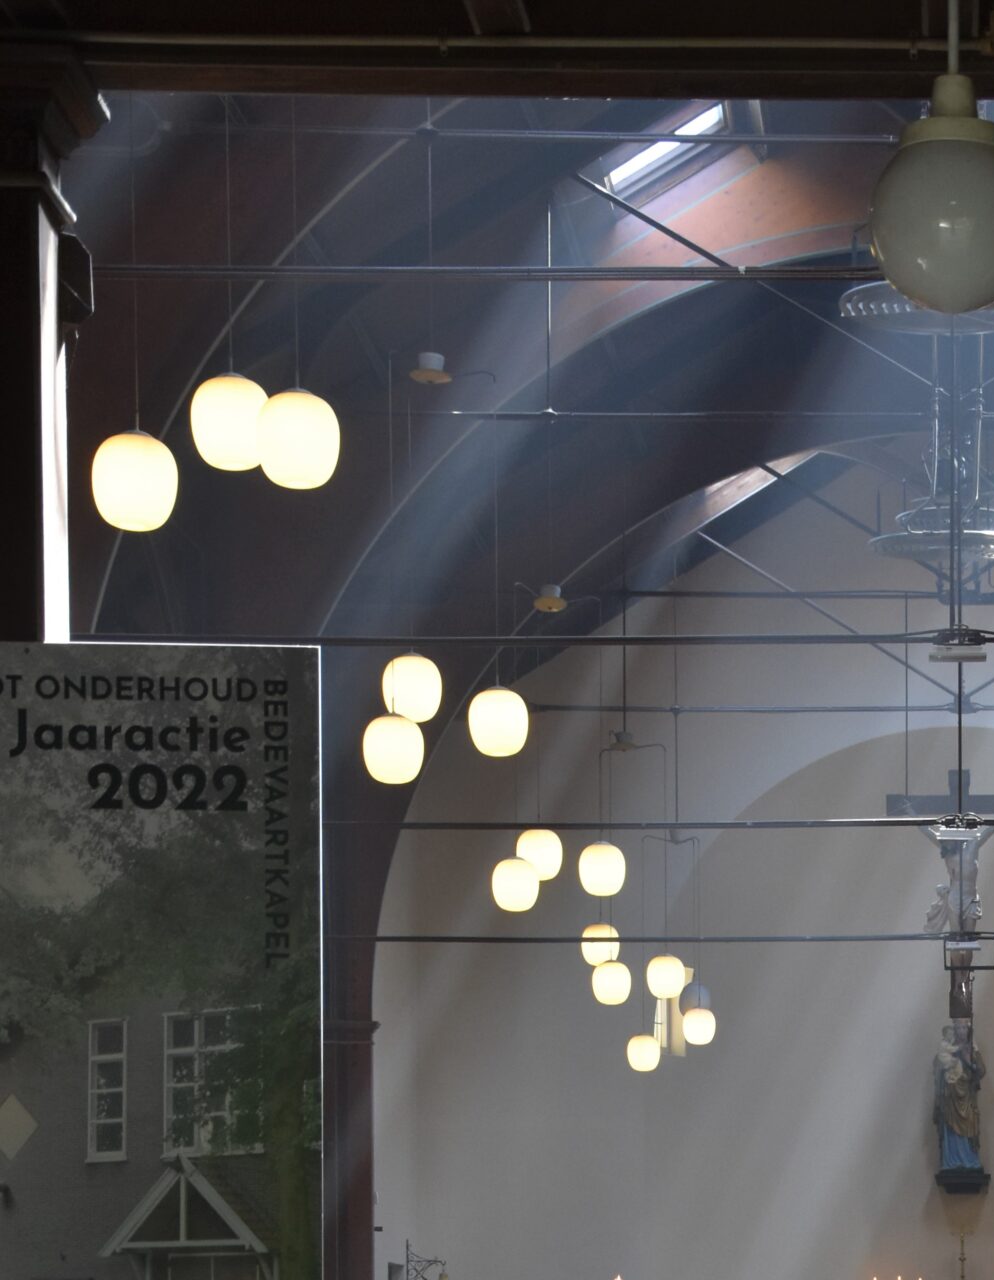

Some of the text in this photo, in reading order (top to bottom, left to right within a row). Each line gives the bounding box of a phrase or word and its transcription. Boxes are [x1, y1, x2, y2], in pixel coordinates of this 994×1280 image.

[0, 674, 258, 702] T ONDERHOUD
[9, 708, 250, 758] Jaaractie
[87, 763, 248, 811] 2022
[263, 680, 290, 969] BEDEVAARTKAPEL
